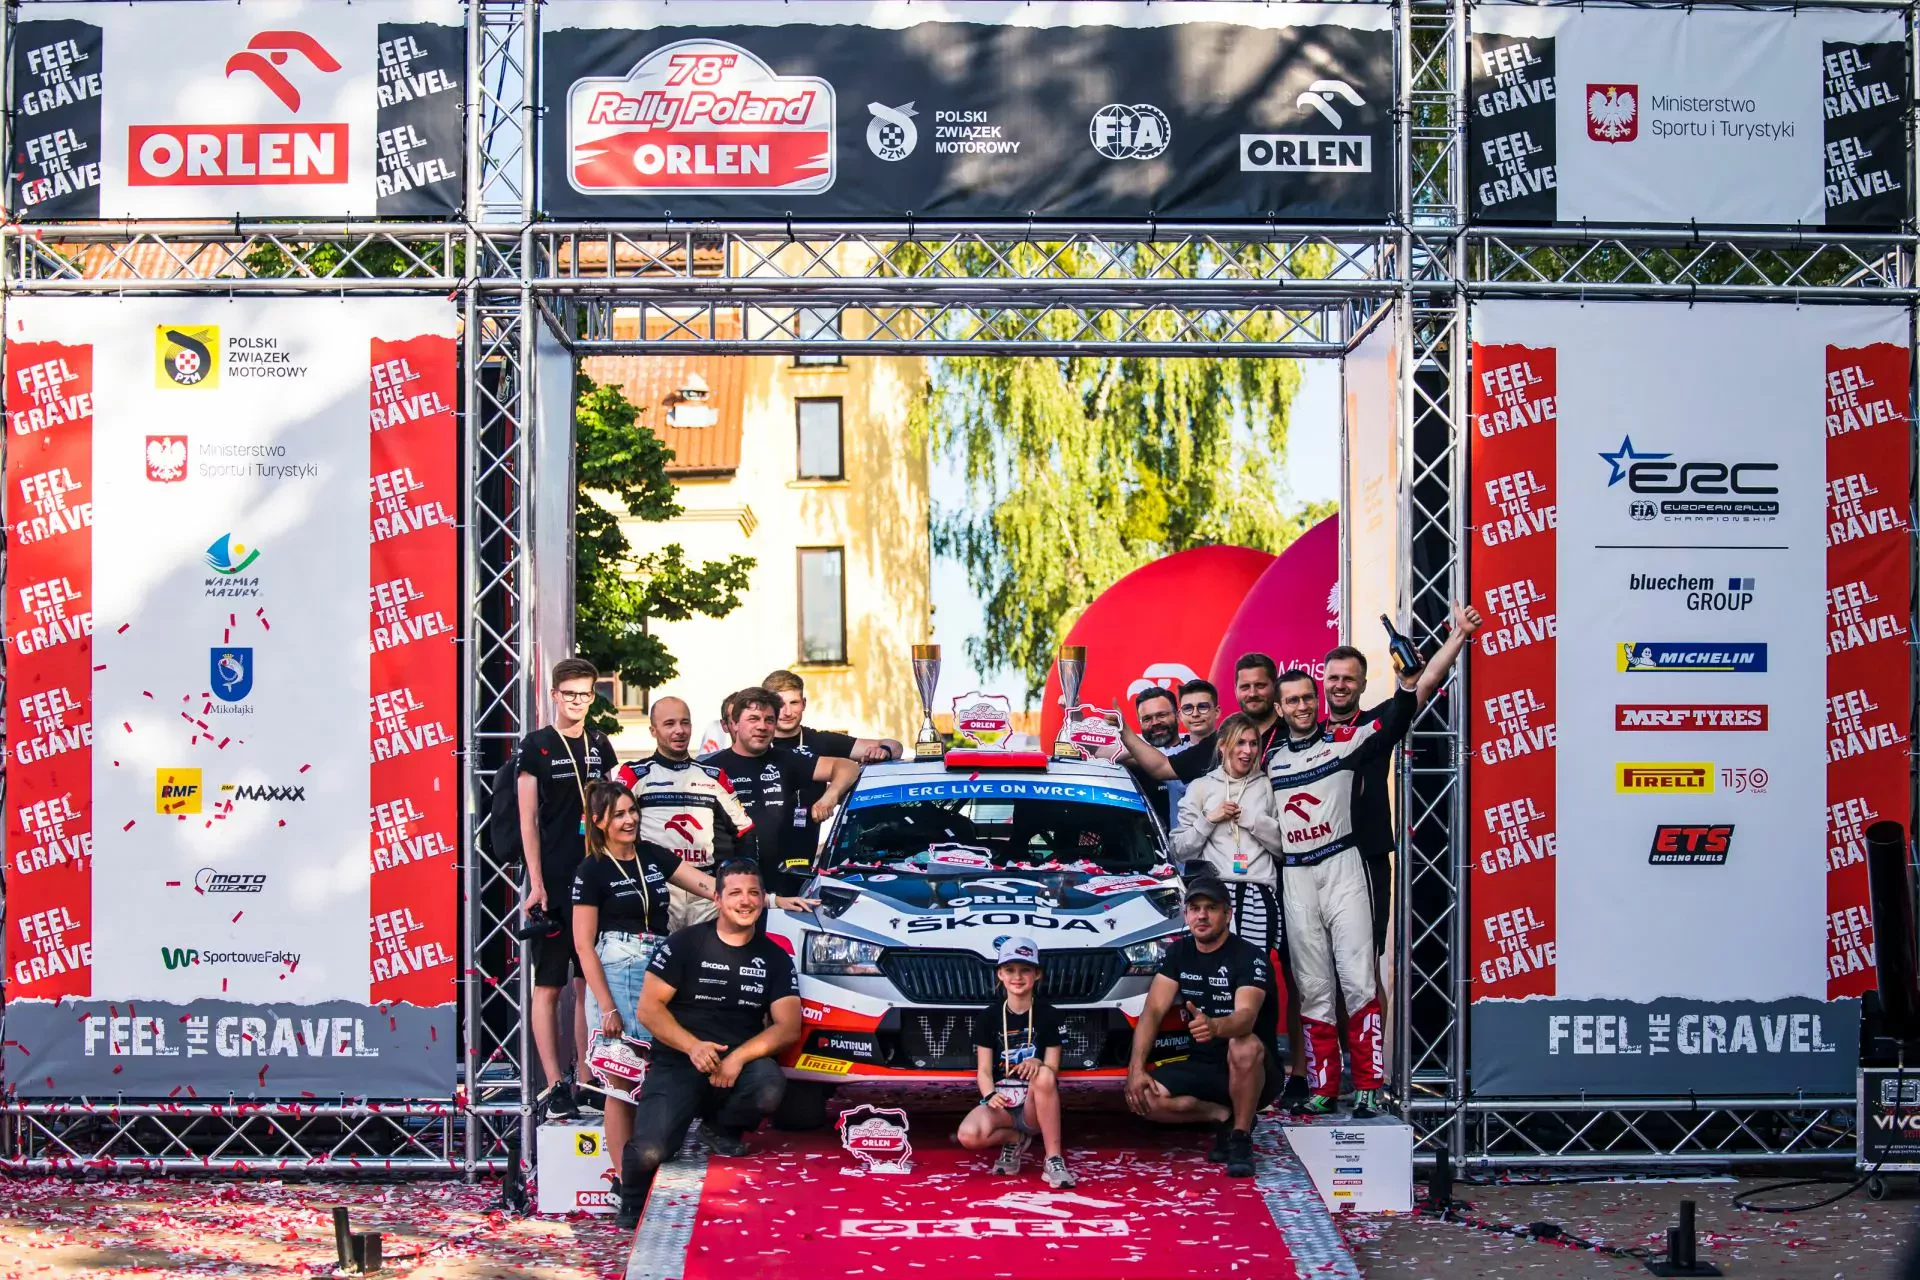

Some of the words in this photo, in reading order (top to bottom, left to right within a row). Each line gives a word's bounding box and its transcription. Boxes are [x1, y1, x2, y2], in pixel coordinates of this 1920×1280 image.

[27, 39, 88, 75] FEEL
[1482, 43, 1542, 77] FEEL
[40, 66, 73, 86] THE
[380, 61, 411, 82] THE
[1495, 69, 1525, 88] THE
[1825, 75, 1856, 93] THE
[587, 91, 684, 131] Rally
[681, 91, 816, 124] Poland
[1652, 95, 1755, 113] Ministerstwo
[936, 111, 987, 123] POLSKI
[936, 126, 1001, 140] ZWIĄZEK
[1652, 120, 1706, 139] Sportu
[1712, 121, 1715, 136] i
[1720, 121, 1795, 140] Turystyki
[25, 129, 87, 164] FEEL
[139, 132, 334, 178] ORLEN
[878, 147, 907, 160] PZM
[935, 142, 1020, 153] MOTOROWY
[1248, 140, 1362, 166] ORLEN
[1482, 131, 1543, 165] FEEL
[39, 155, 72, 176] THE
[379, 151, 410, 172] THE
[633, 144, 769, 174] ORLEN
[1495, 157, 1527, 177] THE
[1826, 161, 1857, 181] THE
[229, 338, 277, 348] POLSKI
[228, 352, 290, 365] ZWIĄZEK
[17, 359, 79, 393] FEEL
[175, 373, 201, 384] PZM
[228, 367, 308, 377] MOTOROWY
[1481, 362, 1542, 396] FEEL
[31, 385, 62, 406] THE
[373, 385, 405, 405] THE
[1495, 388, 1526, 408] THE
[1828, 392, 1859, 412] THE
[200, 445, 285, 456] Ministerstwo
[200, 464, 244, 477] Sportu
[249, 464, 251, 476] i
[256, 463, 318, 479] Turystyki
[1629, 462, 1779, 494] ERC
[20, 468, 83, 503] FEEL
[1485, 471, 1546, 505] FEEL
[34, 493, 66, 515] THE
[376, 494, 408, 515] THE
[1499, 497, 1531, 517] THE
[1832, 500, 1863, 519] THE
[205, 577, 259, 586] WARMIA
[1630, 574, 1713, 590] bluechem
[19, 577, 82, 613] FEEL
[205, 588, 259, 597] MAZURY
[1484, 579, 1546, 614] FEEL
[1687, 593, 1752, 610] GROUP
[34, 604, 66, 625] THE
[376, 603, 408, 625] THE
[1499, 606, 1531, 626] THE
[1832, 607, 1863, 628] THE
[1659, 652, 1754, 663] MICHELIN
[19, 688, 81, 722] FEEL
[210, 705, 254, 716] Mikołajki
[1484, 689, 1545, 723] FEEL
[34, 714, 64, 735] THE
[376, 714, 408, 735] THE
[1498, 715, 1529, 736] THE
[1621, 710, 1690, 726] MRF
[1693, 710, 1762, 725] TYRES
[1832, 716, 1863, 736] THE
[1316, 761, 1339, 774] SERVICES
[1624, 769, 1705, 787] PIRELLI
[162, 786, 197, 798] RMF
[235, 785, 305, 801] MAXXX
[908, 786, 944, 796] ERC
[951, 784, 993, 794] LIVE
[1001, 785, 1026, 793] ON
[1033, 785, 1086, 796] WRC+
[19, 798, 81, 832] FEEL
[1484, 798, 1545, 832] FEEL
[33, 824, 65, 844] THE
[376, 824, 408, 845] THE
[1287, 822, 1331, 843] ORLEN
[1498, 824, 1530, 845] THE
[1657, 828, 1730, 852] ETS
[1832, 823, 1863, 844] THE
[212, 875, 266, 884] MOTO
[948, 896, 1059, 908] ORLEN
[18, 907, 80, 942] FEEL
[907, 913, 1100, 933] ŠKODA
[1483, 907, 1545, 942] FEEL
[33, 933, 64, 954] THE
[376, 935, 407, 955] THE
[1498, 933, 1529, 954] THE
[1832, 932, 1862, 952] THE
[203, 951, 300, 964] SportoweFakty
[701, 961, 730, 970] ŠKODA
[742, 968, 764, 977] ORLEN
[741, 984, 763, 993] verva
[84, 1016, 179, 1056] FEEL
[187, 1016, 208, 1058] THE
[216, 1016, 379, 1057] GRAVEL
[1550, 1015, 1641, 1054] FEEL
[1649, 1013, 1670, 1055] THE
[1677, 1013, 1835, 1054] GRAVEL
[831, 1040, 872, 1051] PLATINUM
[604, 1061, 630, 1074] ORLEN
[802, 1055, 847, 1072] PIRELLI
[856, 1222, 1124, 1236] ORLEN
